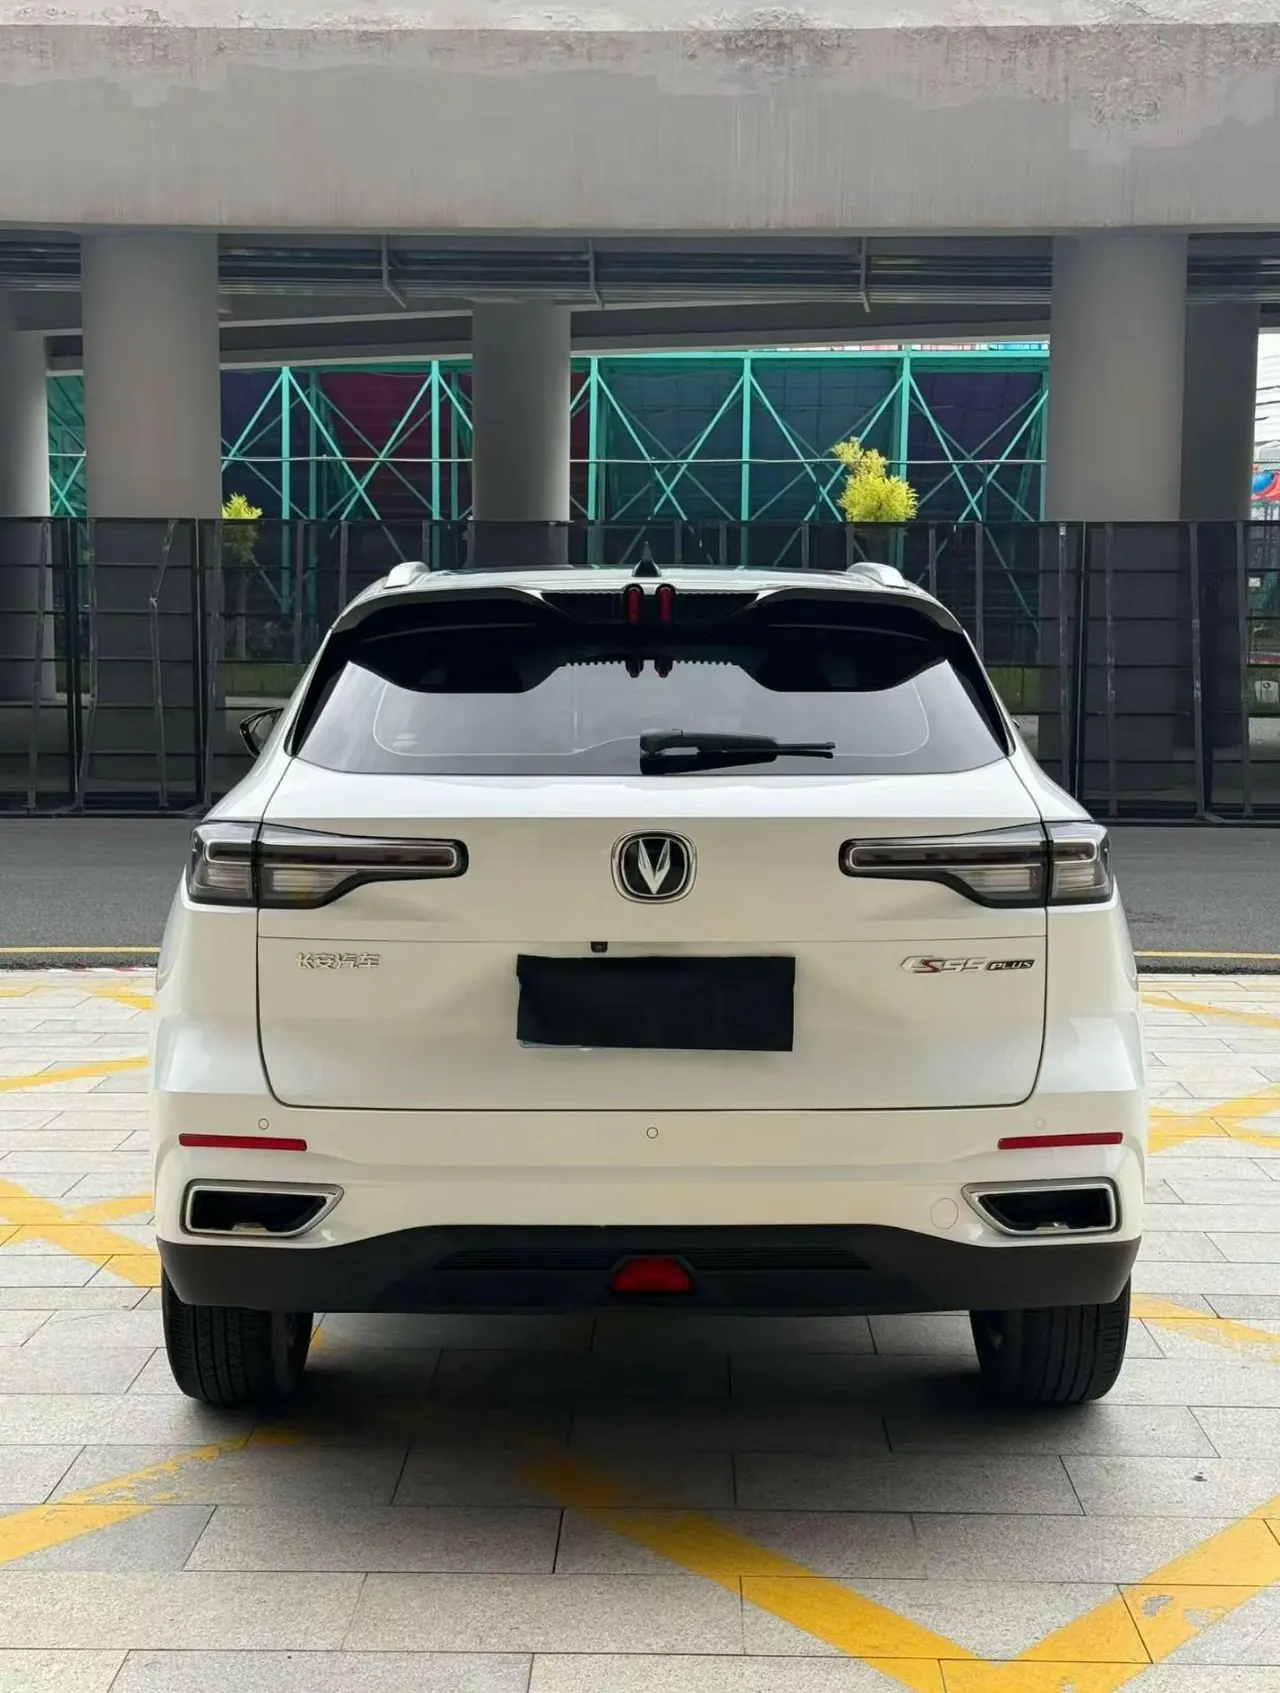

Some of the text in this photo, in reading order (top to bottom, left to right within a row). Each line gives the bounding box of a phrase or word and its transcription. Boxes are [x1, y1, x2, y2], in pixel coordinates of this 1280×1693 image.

[296, 952, 380, 969] 长安汽车
[988, 960, 1034, 971] PLUS
